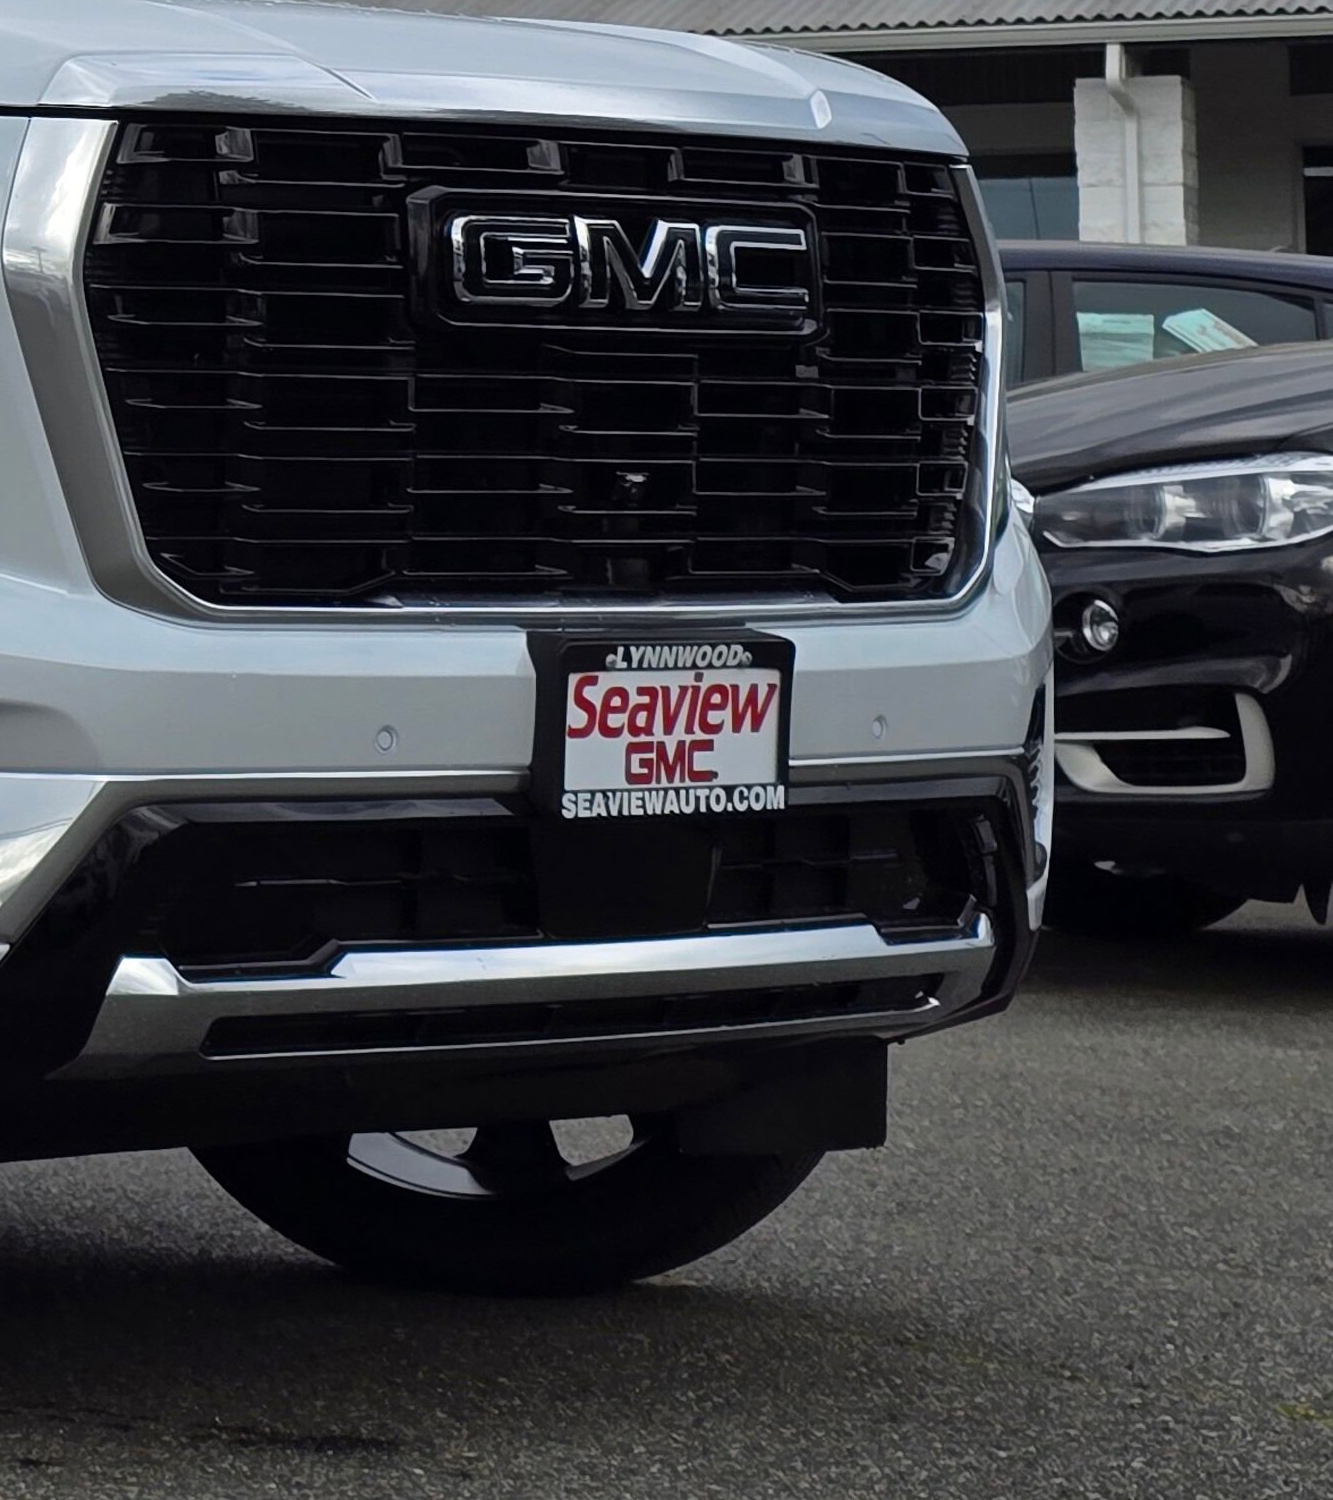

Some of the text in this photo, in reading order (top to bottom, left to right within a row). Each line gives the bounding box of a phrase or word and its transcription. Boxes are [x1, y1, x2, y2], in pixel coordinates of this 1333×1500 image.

[450, 215, 810, 312] GMC
[616, 644, 743, 669] LYNNWOOD
[567, 672, 778, 739] Seaview
[625, 739, 717, 785] GMC
[561, 785, 785, 819] SEAVIEWAUTO.COM
